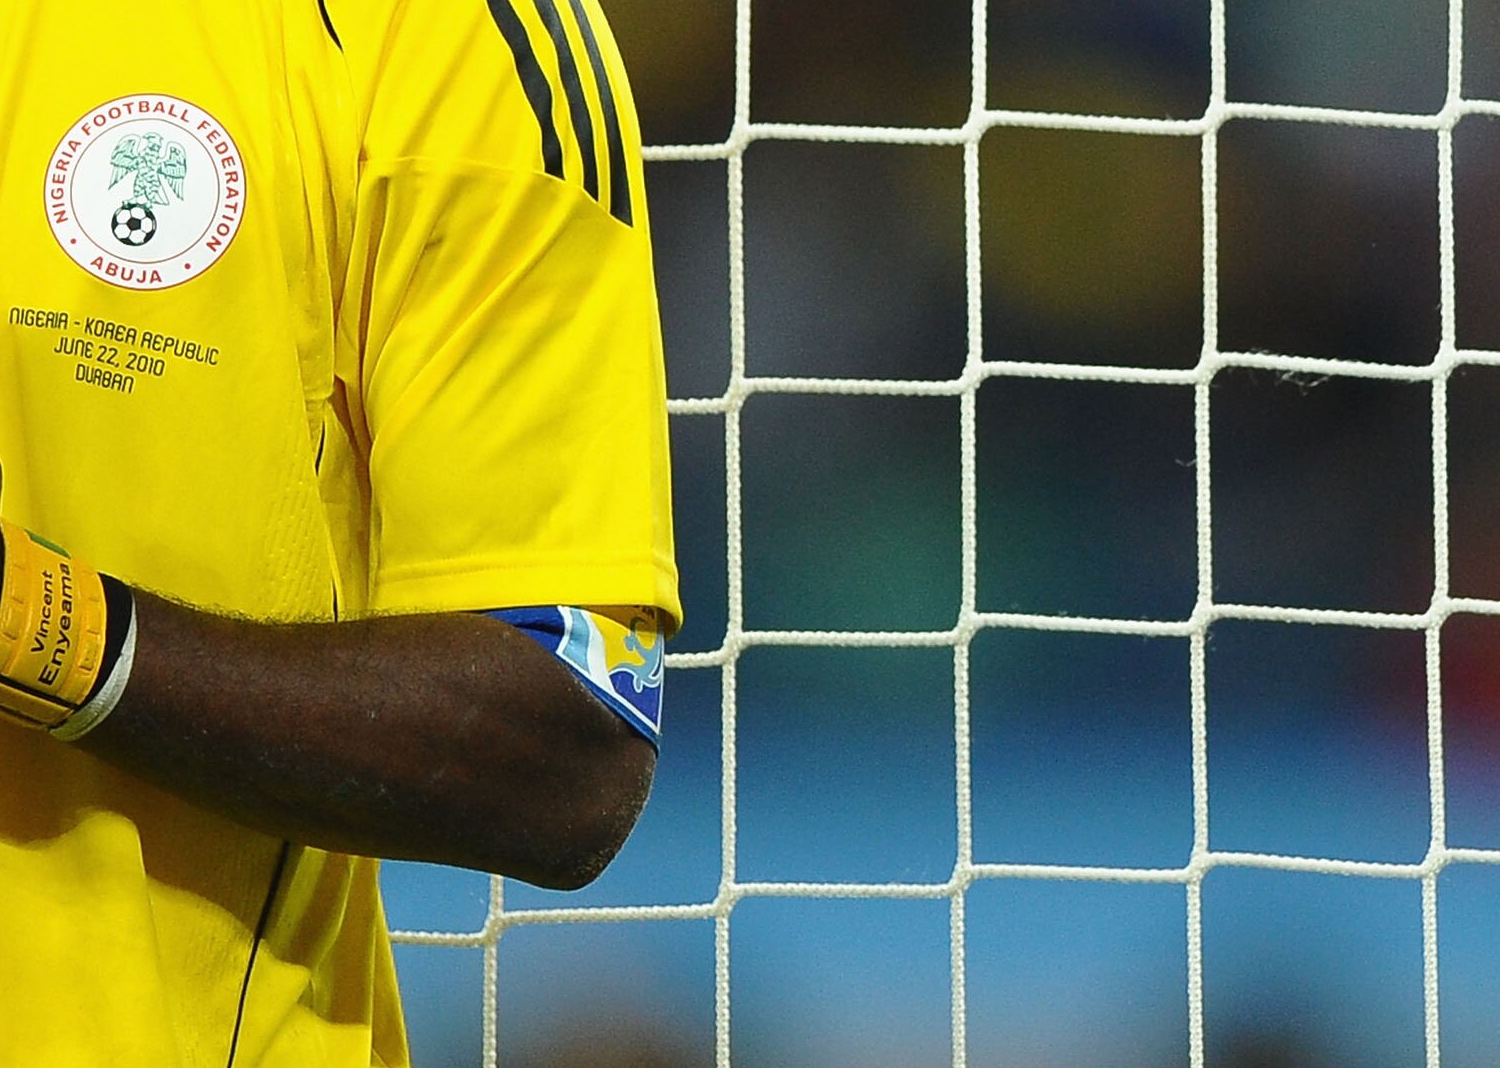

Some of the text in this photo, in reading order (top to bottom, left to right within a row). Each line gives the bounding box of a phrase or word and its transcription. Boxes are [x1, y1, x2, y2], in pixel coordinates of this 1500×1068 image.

[51, 101, 239, 252] NIGERIA FOOTBALL FEDERATION
[91, 256, 162, 283] ABUJA
[9, 307, 69, 330] NIGERIA
[84, 317, 137, 345] KOREA
[140, 331, 219, 366] REPUBLIC
[54, 337, 165, 377] JUNE 22, 2010
[75, 363, 134, 394] DURBAN
[30, 570, 53, 653] Vincent
[37, 563, 73, 686] Enyeama
